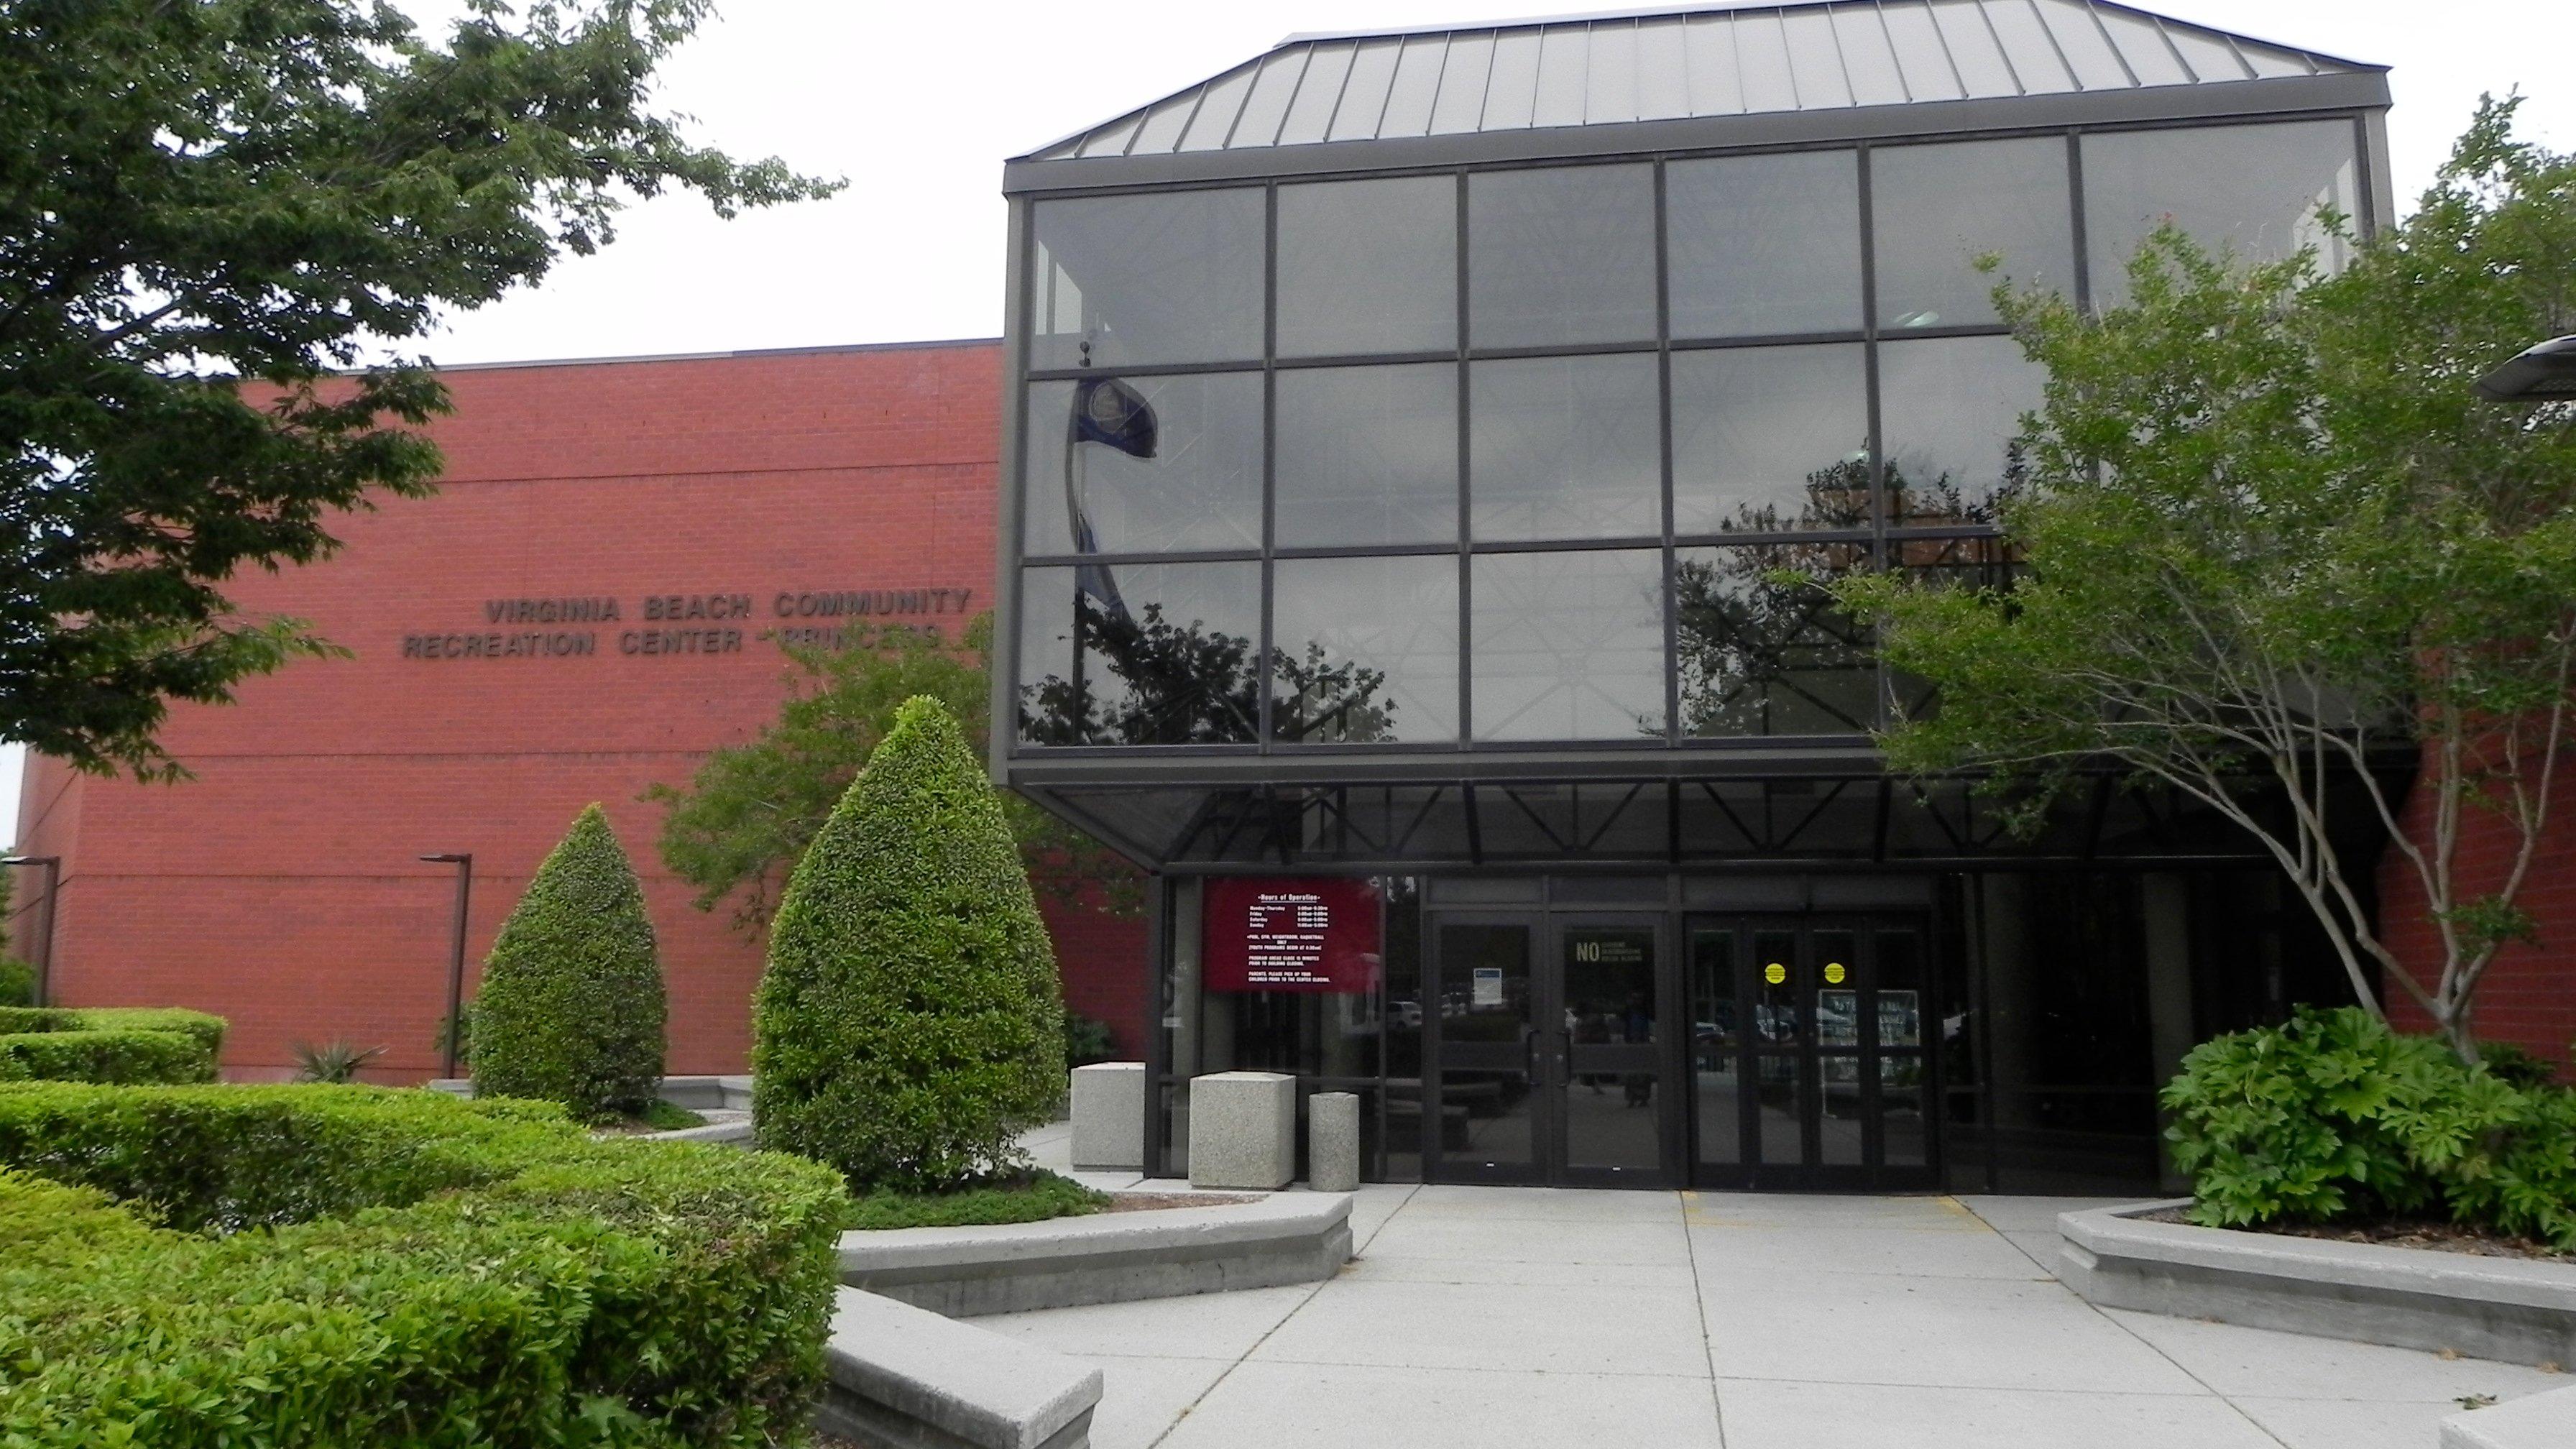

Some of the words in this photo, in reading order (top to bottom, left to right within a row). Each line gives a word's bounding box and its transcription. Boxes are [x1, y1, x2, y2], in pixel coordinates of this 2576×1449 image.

[486, 597, 621, 624] VIRGINIA
[643, 594, 750, 621] BEACH
[774, 589, 973, 618] COMMUNITY
[403, 632, 597, 658] RECREATION
[618, 627, 743, 656] CENTER
[779, 624, 943, 651] PRINCS
[1576, 942, 1600, 962] NO
